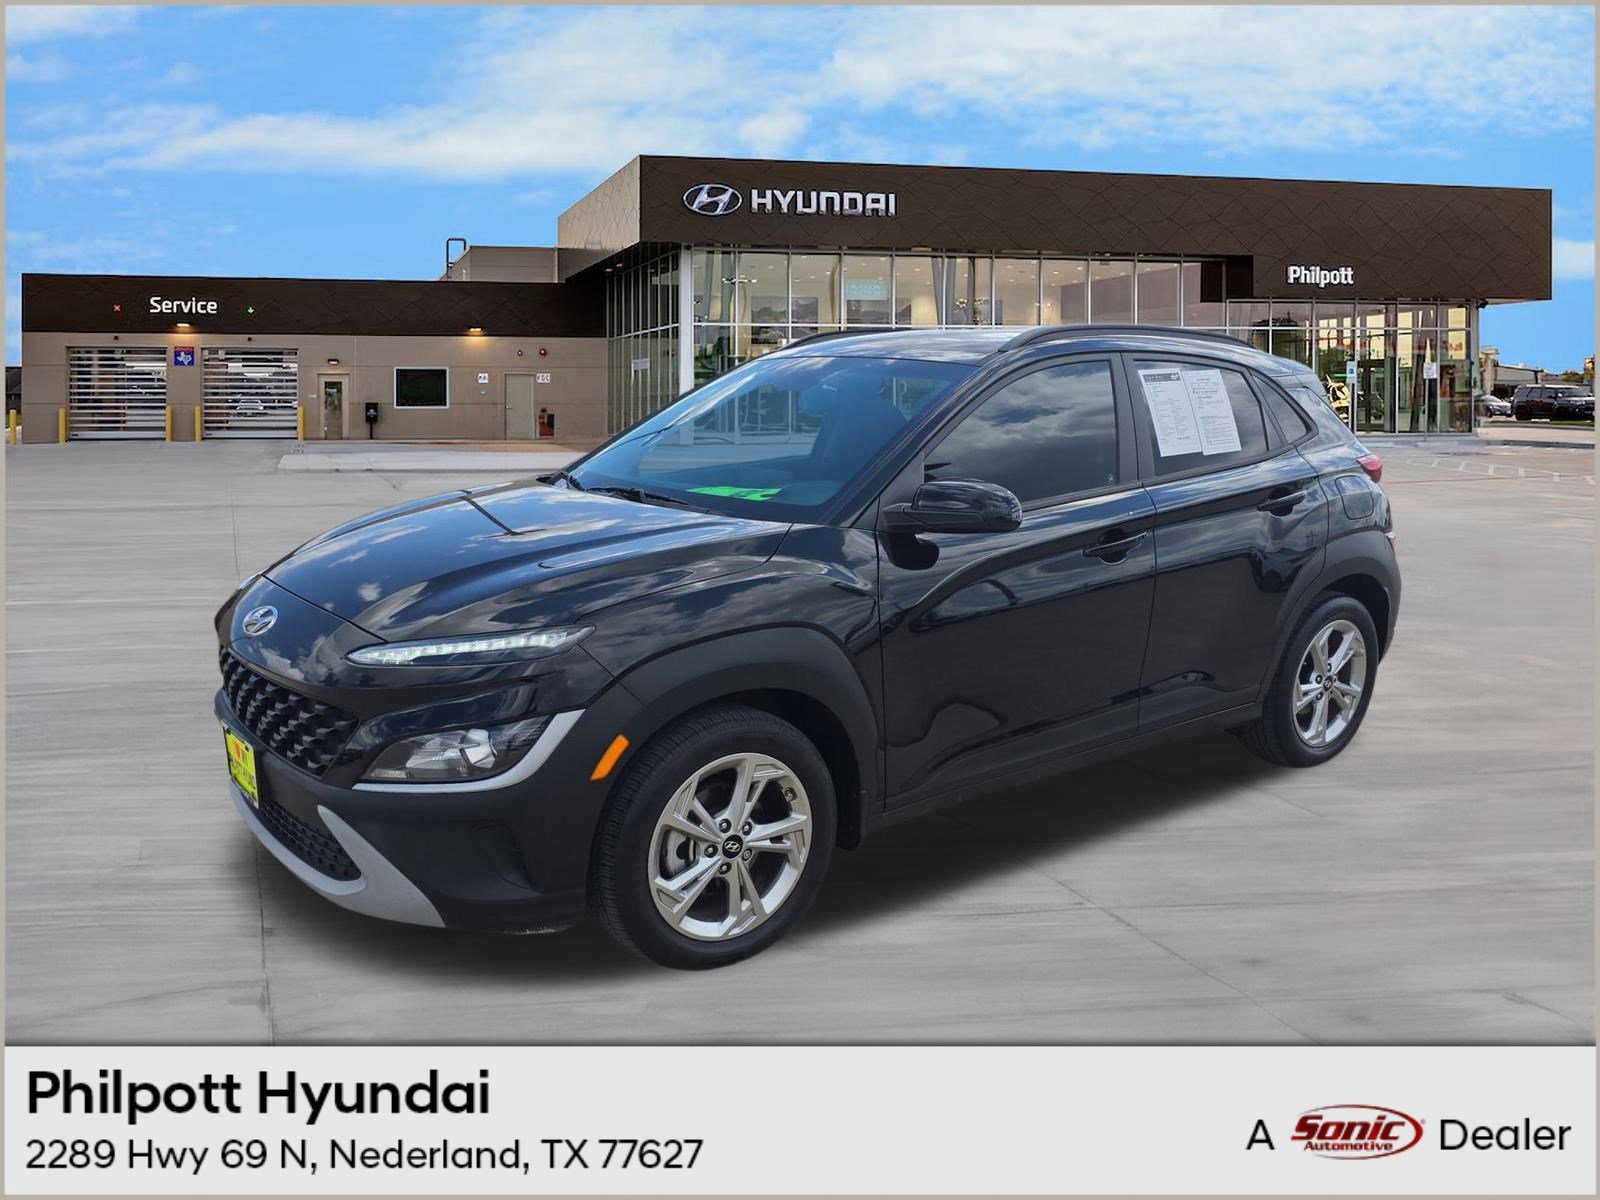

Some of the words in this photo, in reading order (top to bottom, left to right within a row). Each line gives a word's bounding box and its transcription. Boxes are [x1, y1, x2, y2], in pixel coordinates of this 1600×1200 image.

[751, 189, 896, 216] HYUNDAI
[1287, 265, 1354, 288] Philpott
[149, 296, 218, 315] Service
